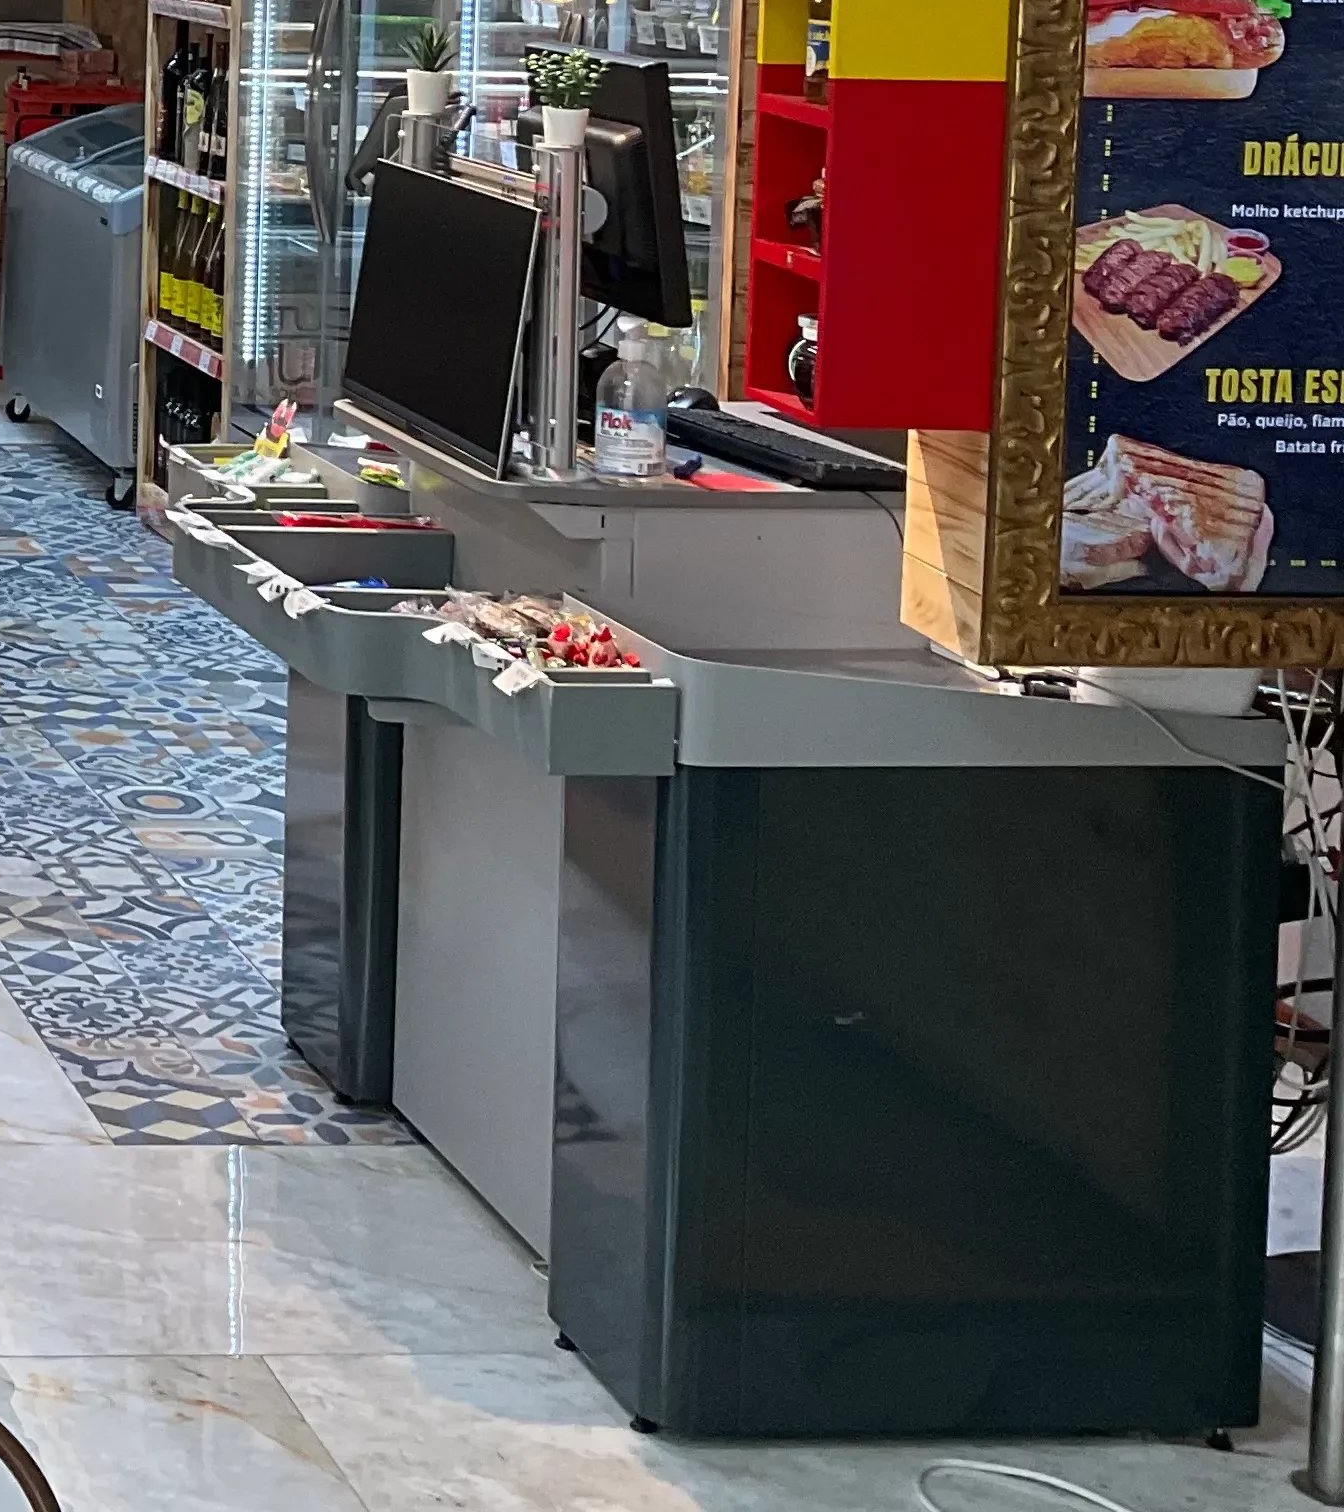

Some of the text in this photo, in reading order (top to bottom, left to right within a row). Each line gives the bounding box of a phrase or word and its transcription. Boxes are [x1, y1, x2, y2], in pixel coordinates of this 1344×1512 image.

[1243, 134, 1344, 177] DRÁCU
[1231, 204, 1344, 222] Molho ketchup
[1205, 368, 1294, 403] TOSTA
[1217, 413, 1251, 429] Pão,
[1255, 413, 1308, 430] queijo,
[1275, 439, 1326, 454] Batata
